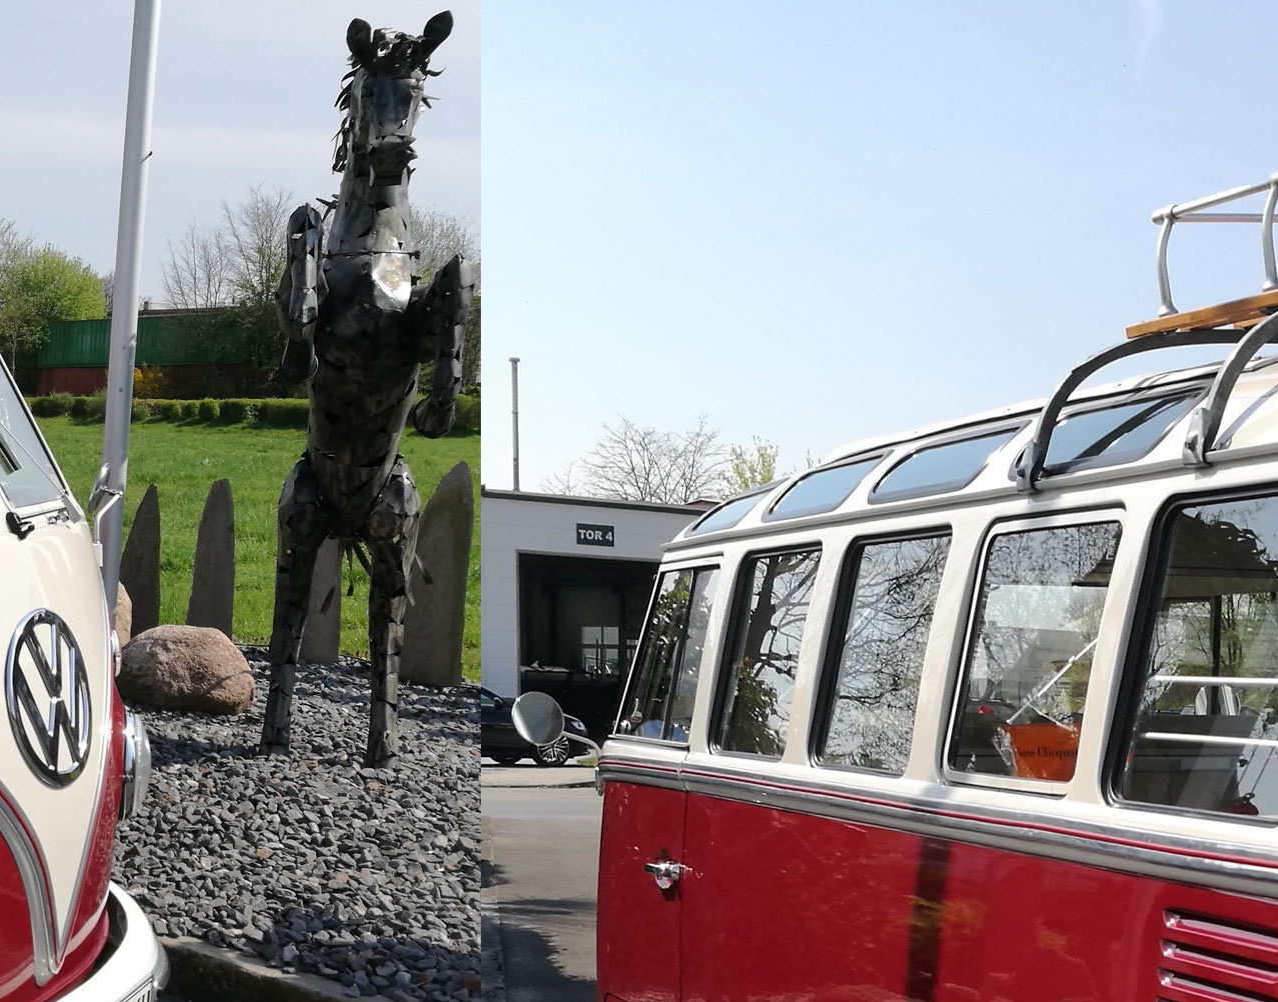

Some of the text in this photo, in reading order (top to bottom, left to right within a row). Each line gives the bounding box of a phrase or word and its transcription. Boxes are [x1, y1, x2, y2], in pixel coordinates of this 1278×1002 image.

[578, 529, 613, 541] TOR 4
[8, 611, 89, 785] VW
